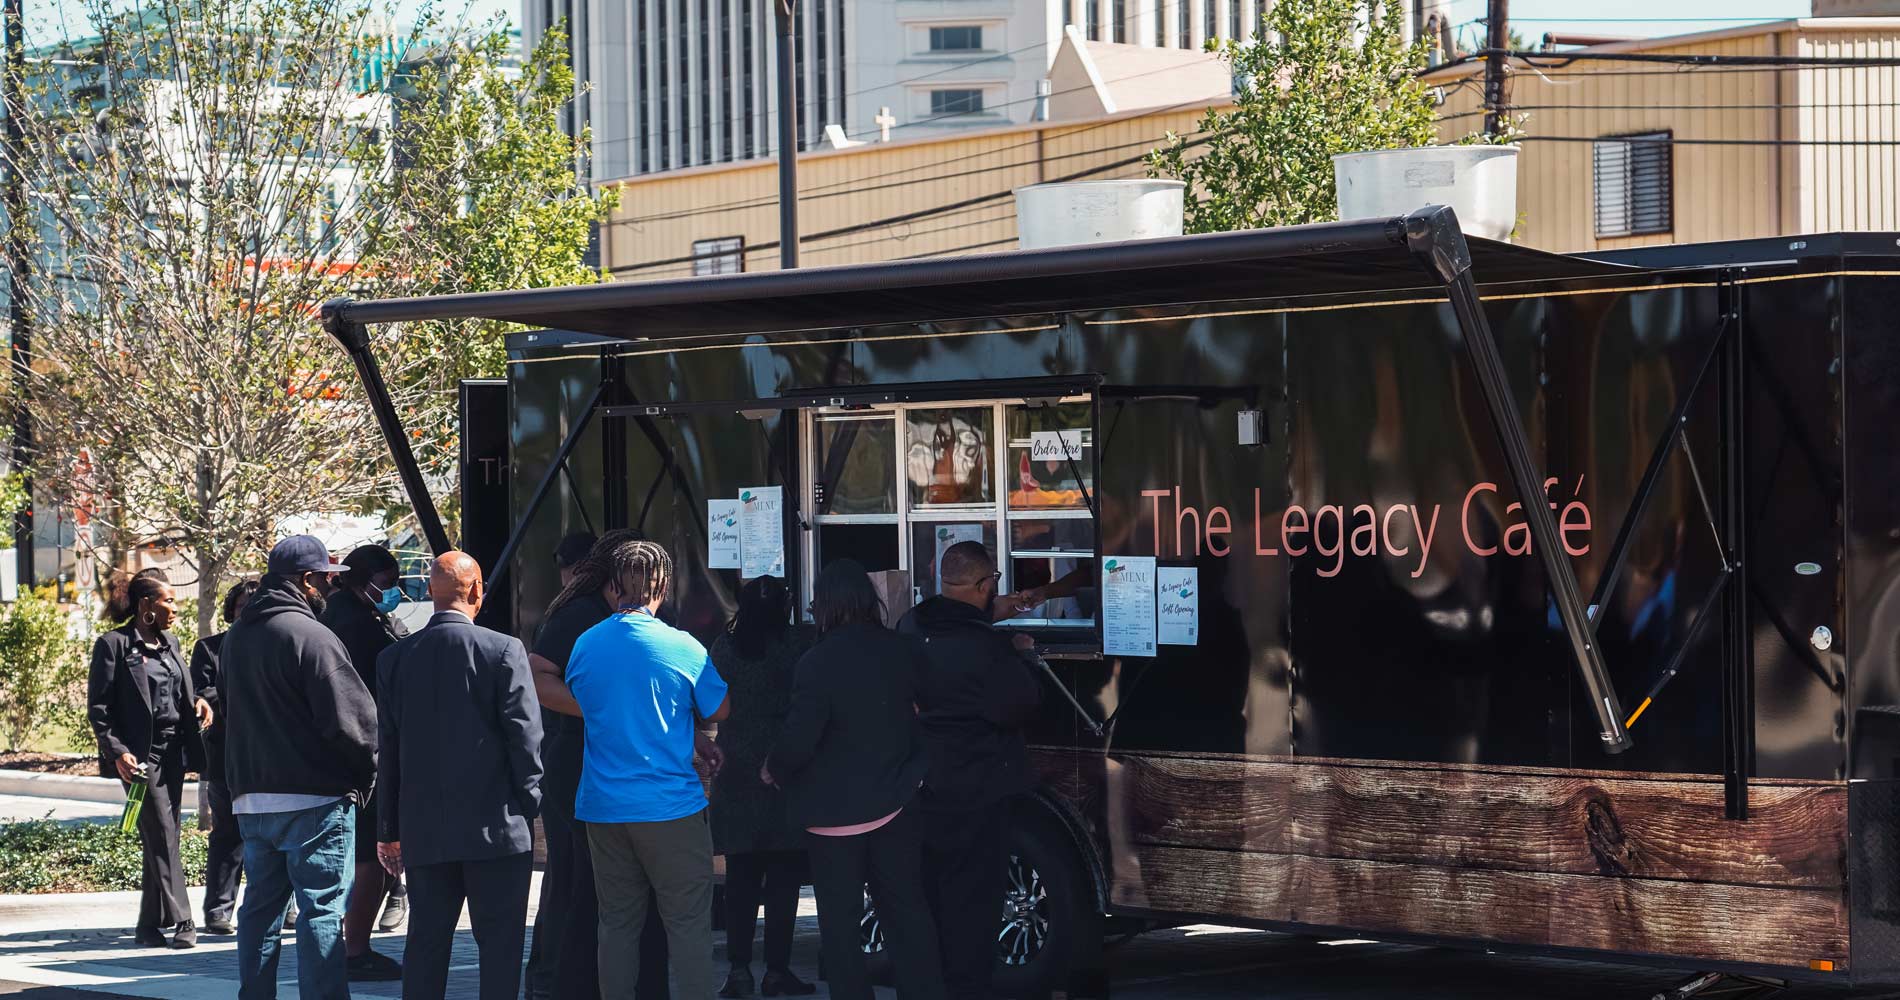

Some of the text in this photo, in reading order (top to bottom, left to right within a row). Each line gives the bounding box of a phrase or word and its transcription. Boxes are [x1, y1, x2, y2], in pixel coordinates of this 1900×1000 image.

[1034, 438, 1080, 456] Order Here
[752, 500, 776, 511] MENU
[1141, 485, 1232, 557] The
[1254, 487, 1440, 578] Legacy
[1120, 571, 1147, 583] MENU
[1162, 604, 1194, 617] Soft Opening
